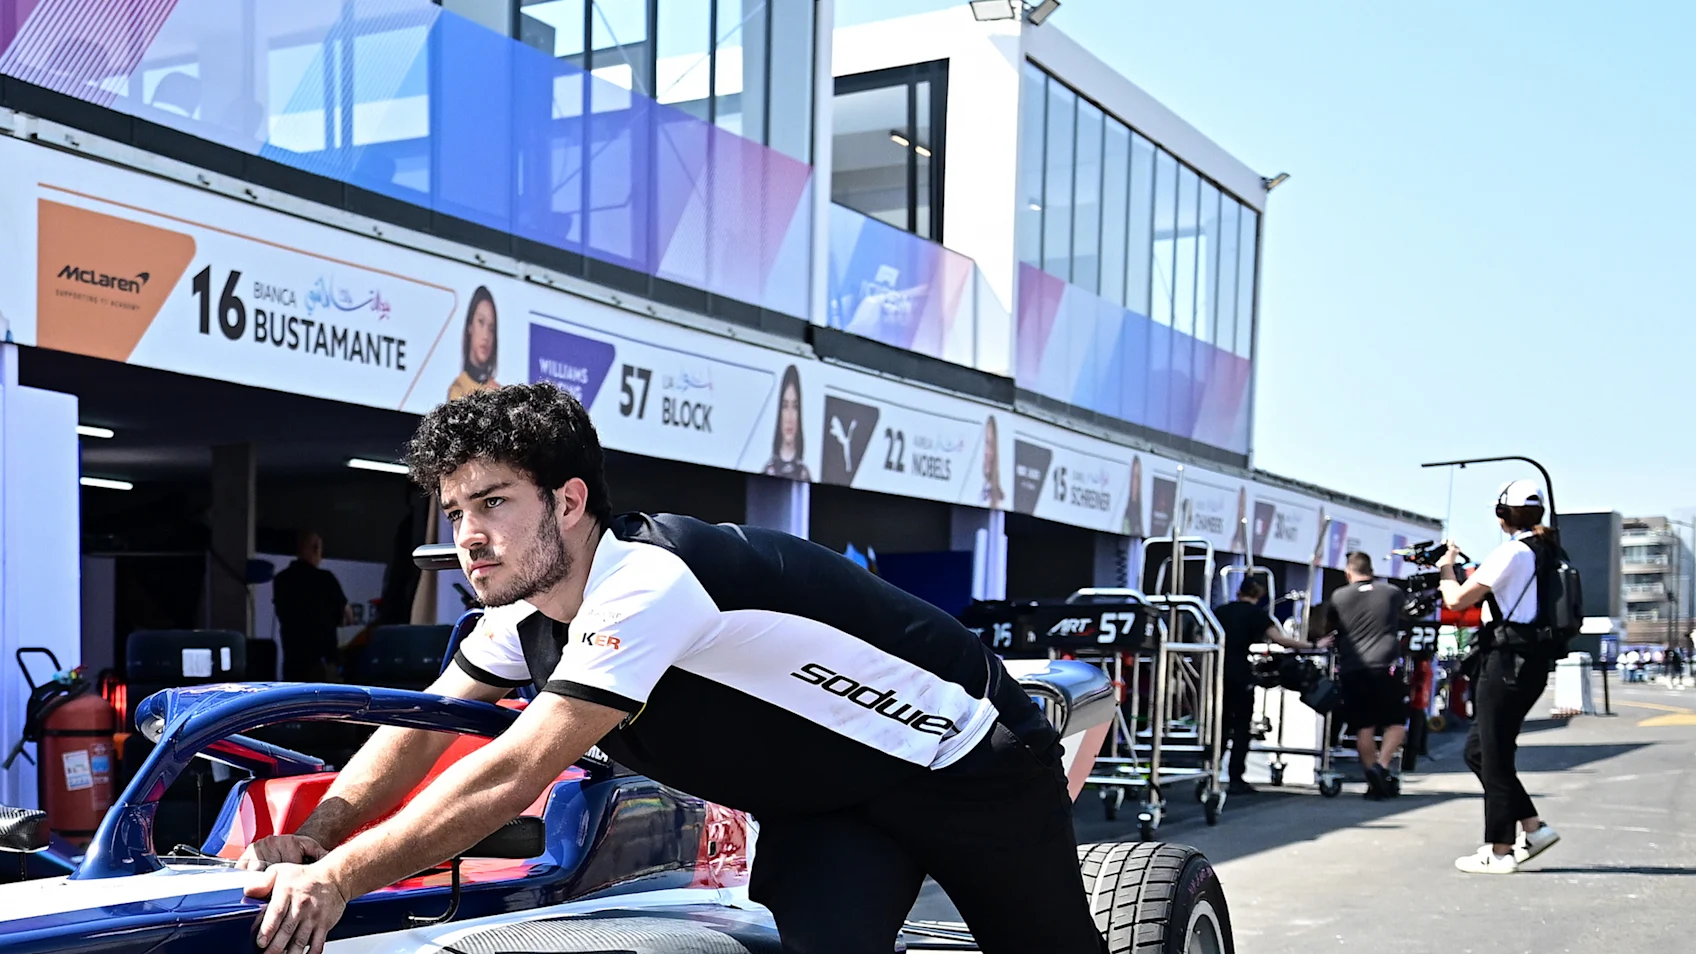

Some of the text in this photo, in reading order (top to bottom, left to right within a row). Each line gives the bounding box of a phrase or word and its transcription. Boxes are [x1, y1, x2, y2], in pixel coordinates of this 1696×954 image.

[57, 264, 140, 294] McLaren
[253, 281, 297, 308] BIANCA
[192, 264, 247, 341] 16
[253, 307, 407, 372] BUSTAMANTE
[538, 356, 589, 384] WILLIAMS
[619, 363, 652, 420] 57
[661, 395, 713, 434] BLOCK
[883, 426, 906, 473] 22
[1097, 612, 1136, 643] 57
[1409, 626, 1436, 651] 22
[790, 662, 961, 744] sodwe
